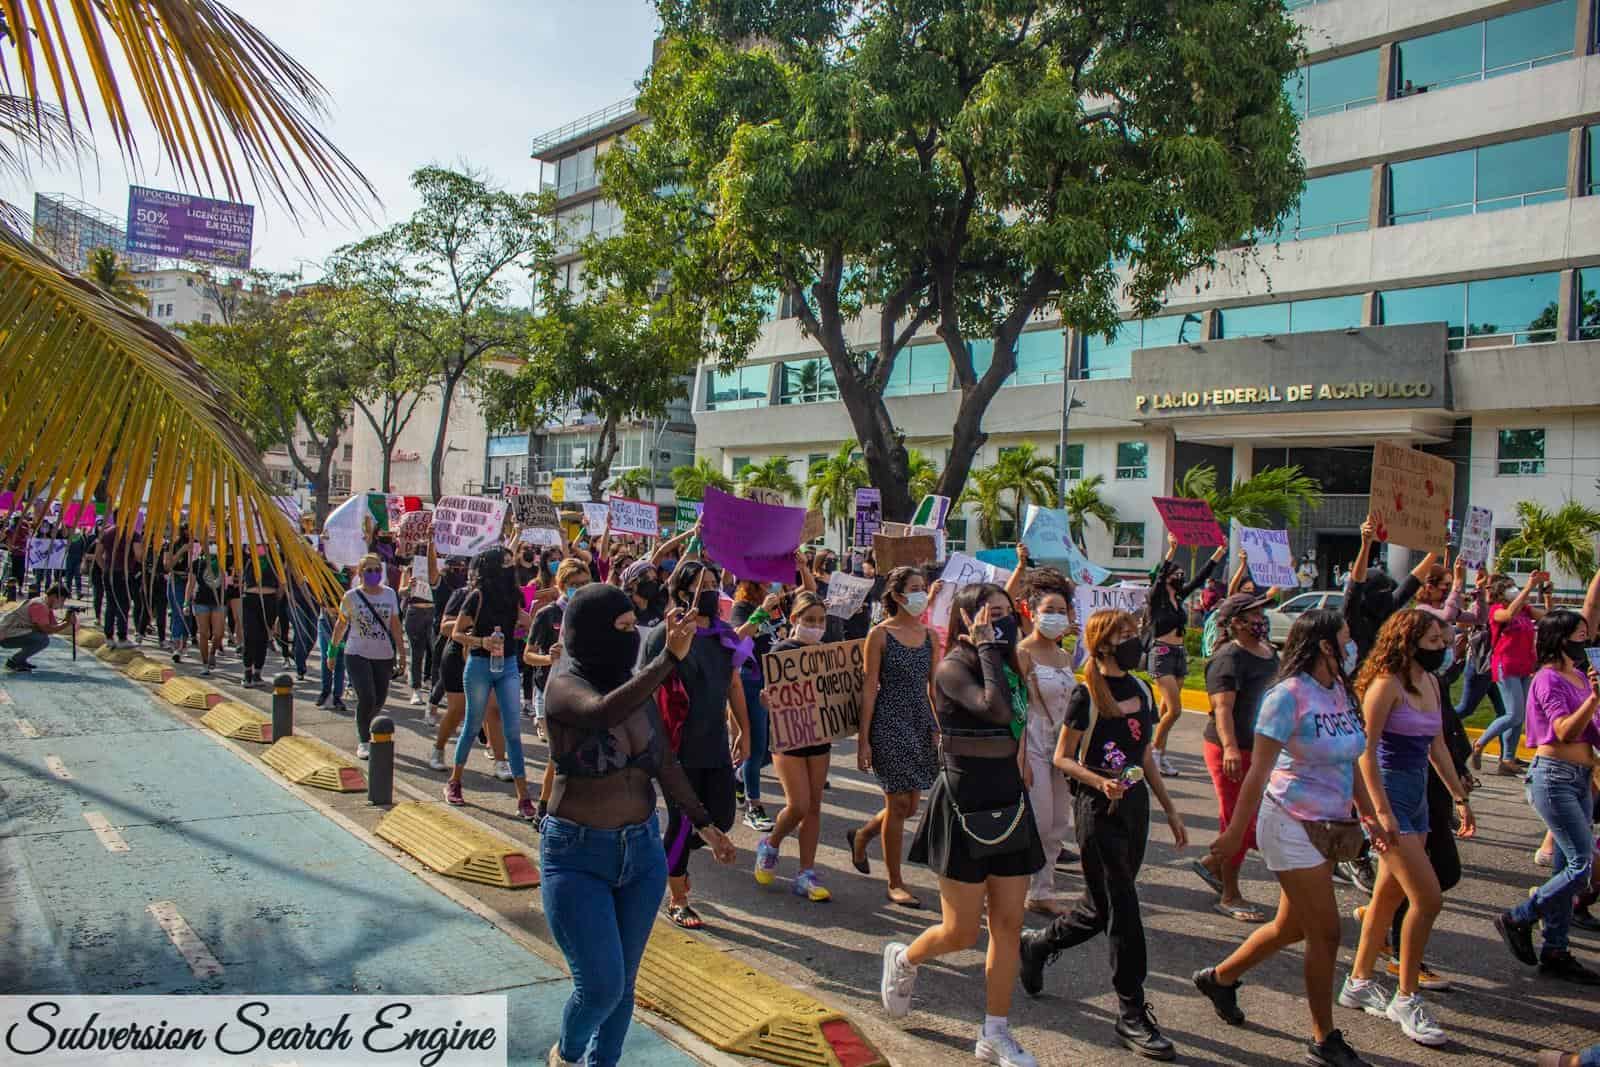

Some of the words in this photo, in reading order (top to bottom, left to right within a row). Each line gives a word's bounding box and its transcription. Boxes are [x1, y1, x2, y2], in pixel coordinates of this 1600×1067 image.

[137, 209, 168, 224] 50%
[187, 208, 251, 225] LICENCIATURA
[206, 221, 250, 234] EJECUTIVA
[1202, 385, 1282, 406] FEDERAL
[1287, 384, 1313, 402] DE
[1318, 382, 1434, 401] ACAPULCO
[636, 517, 656, 530] MIEDO
[1090, 590, 1137, 608] JUNTAS
[766, 654, 798, 684] De
[800, 645, 847, 677] camino
[850, 645, 863, 667] a
[769, 679, 817, 709] casa
[816, 671, 852, 708] quiero
[772, 703, 822, 748] LIBRE
[819, 706, 841, 738] no
